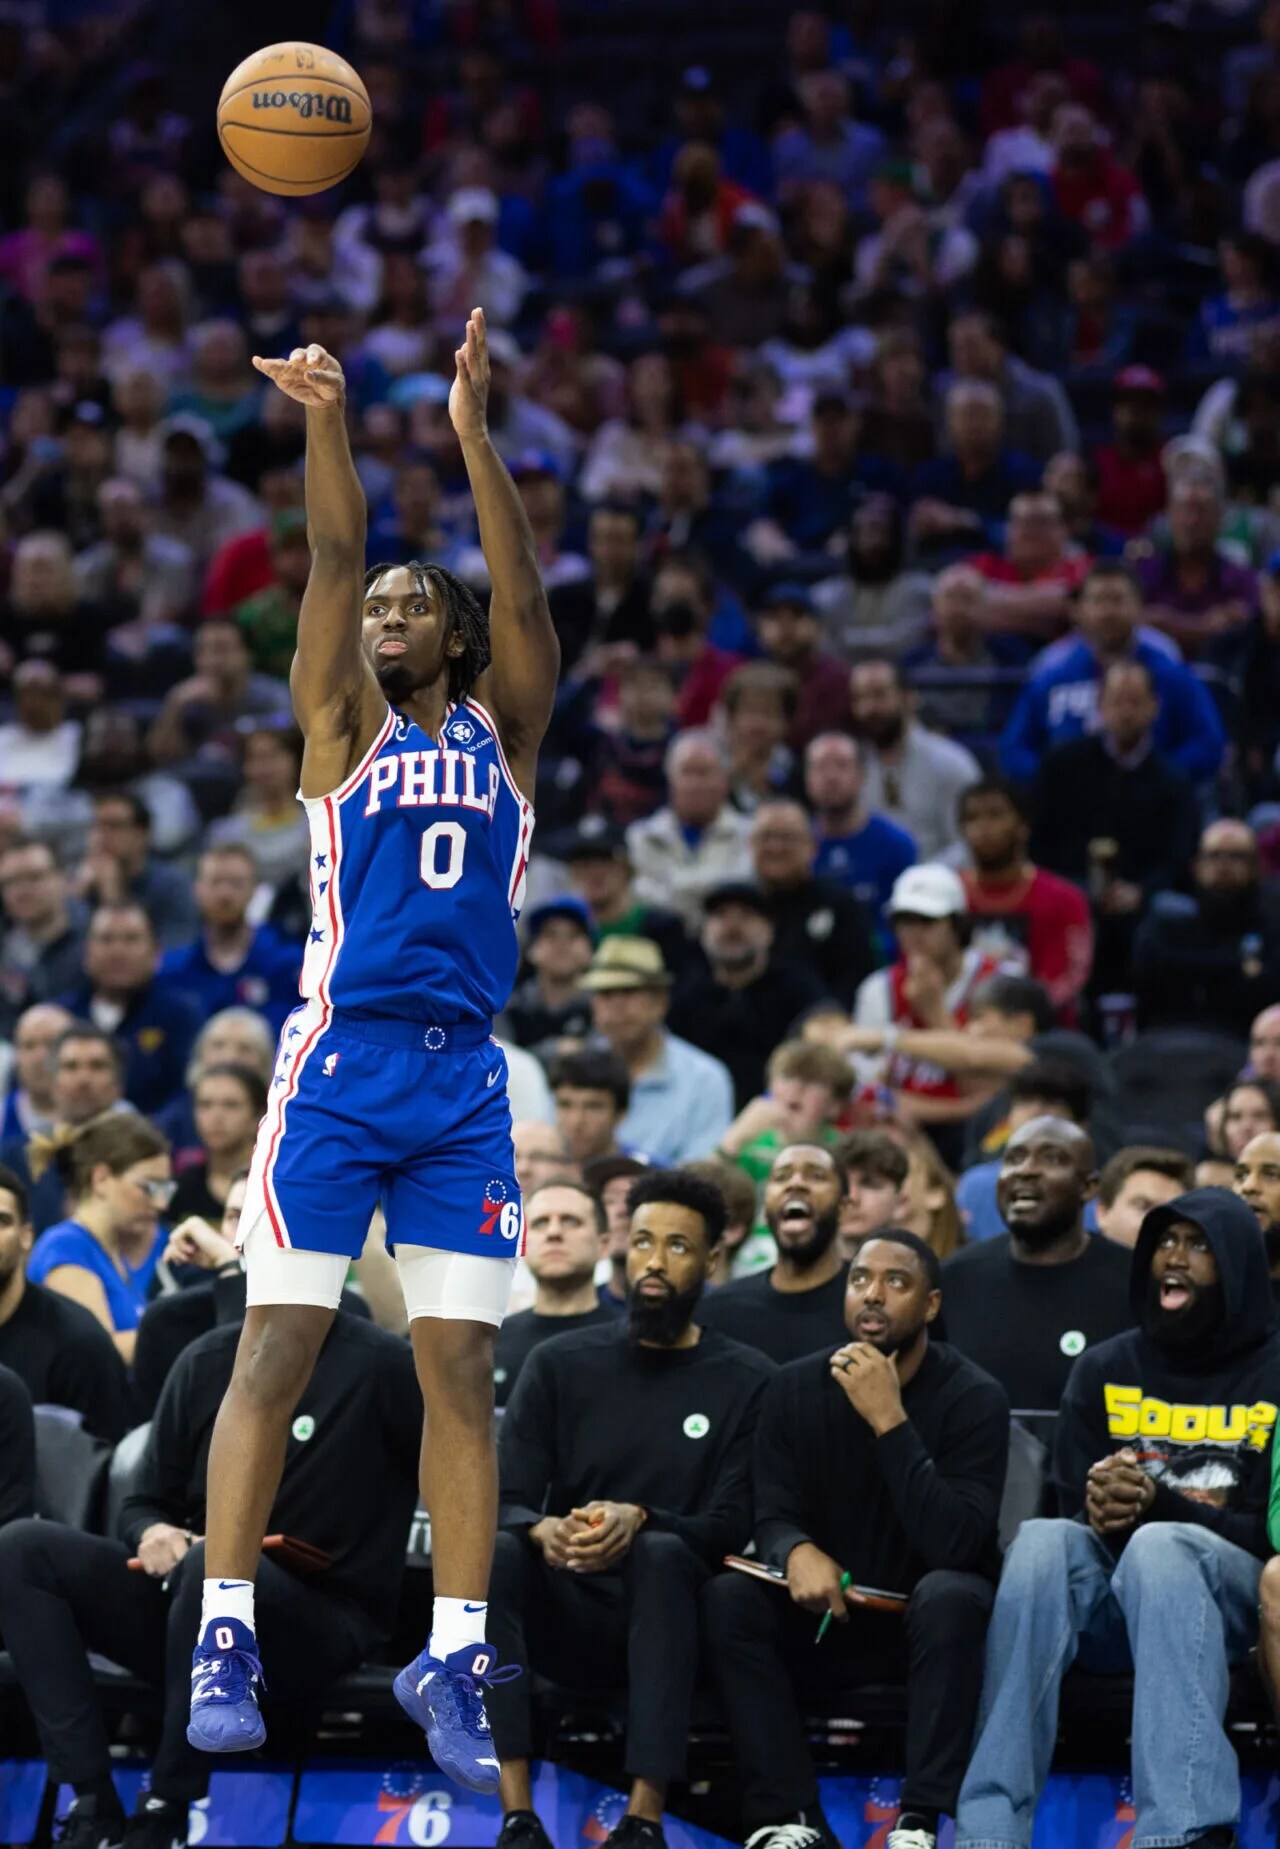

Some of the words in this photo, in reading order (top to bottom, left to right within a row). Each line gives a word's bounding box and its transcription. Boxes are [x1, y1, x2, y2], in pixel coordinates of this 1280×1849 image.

[251, 92, 352, 124] Wilson
[420, 821, 468, 891] 0
[477, 1196, 520, 1240] 76
[215, 1626, 234, 1650] 0
[471, 1653, 490, 1676] 0
[373, 1790, 452, 1848] 76
